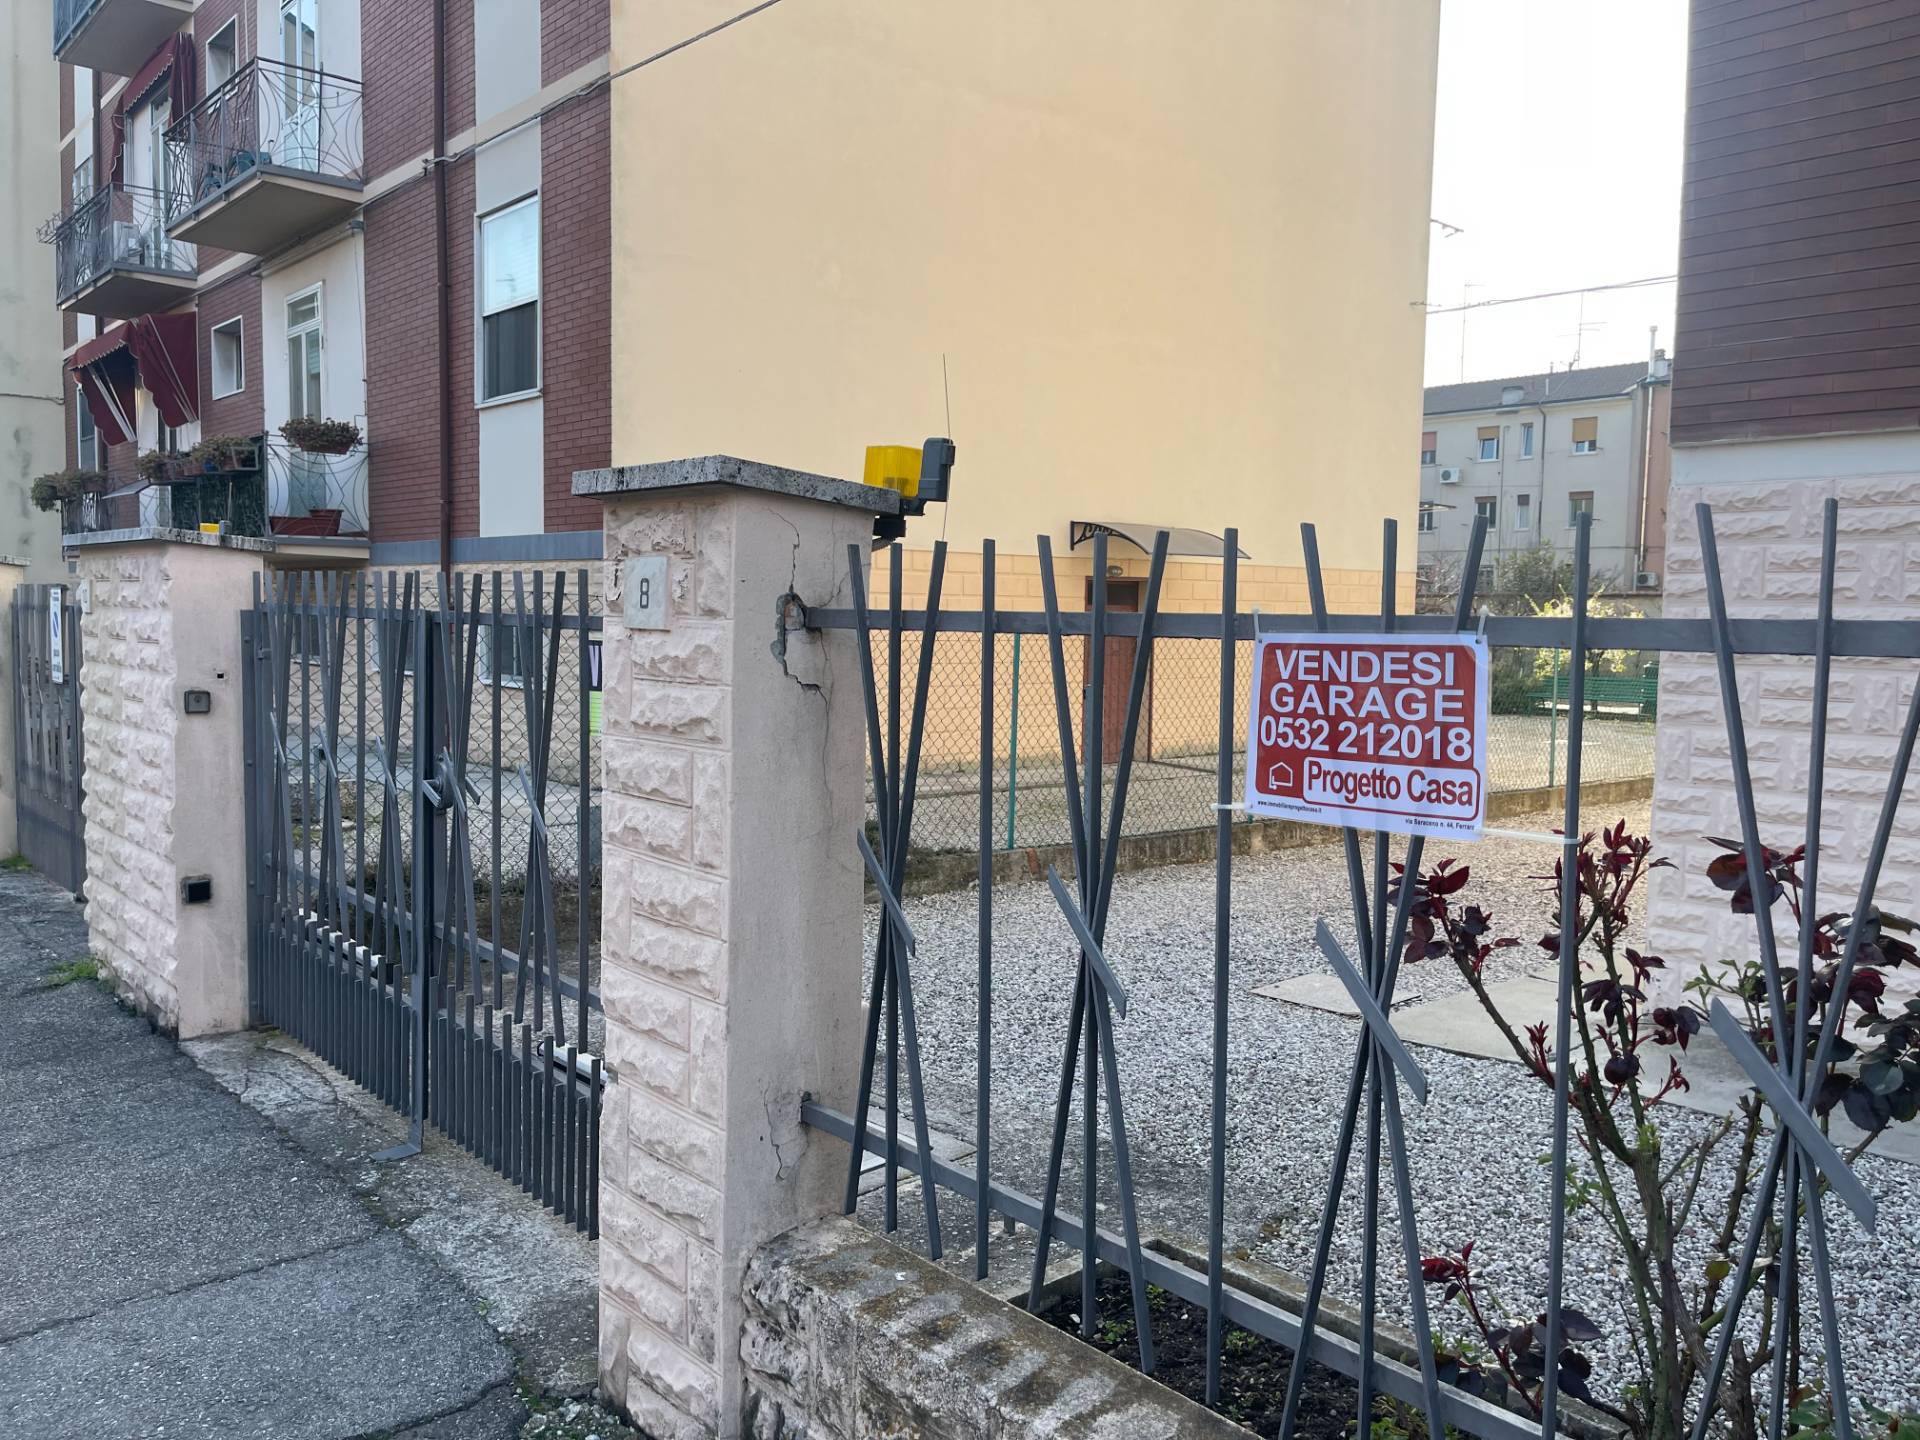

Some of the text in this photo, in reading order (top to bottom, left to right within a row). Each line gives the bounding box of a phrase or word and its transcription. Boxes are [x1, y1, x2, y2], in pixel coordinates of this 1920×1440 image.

[639, 577, 650, 610] 8
[1275, 649, 1455, 686] VENDESI
[1269, 682, 1465, 723] GARAGE
[1260, 715, 1473, 762] 0532 212018
[1307, 760, 1473, 807] Progetto Casa
